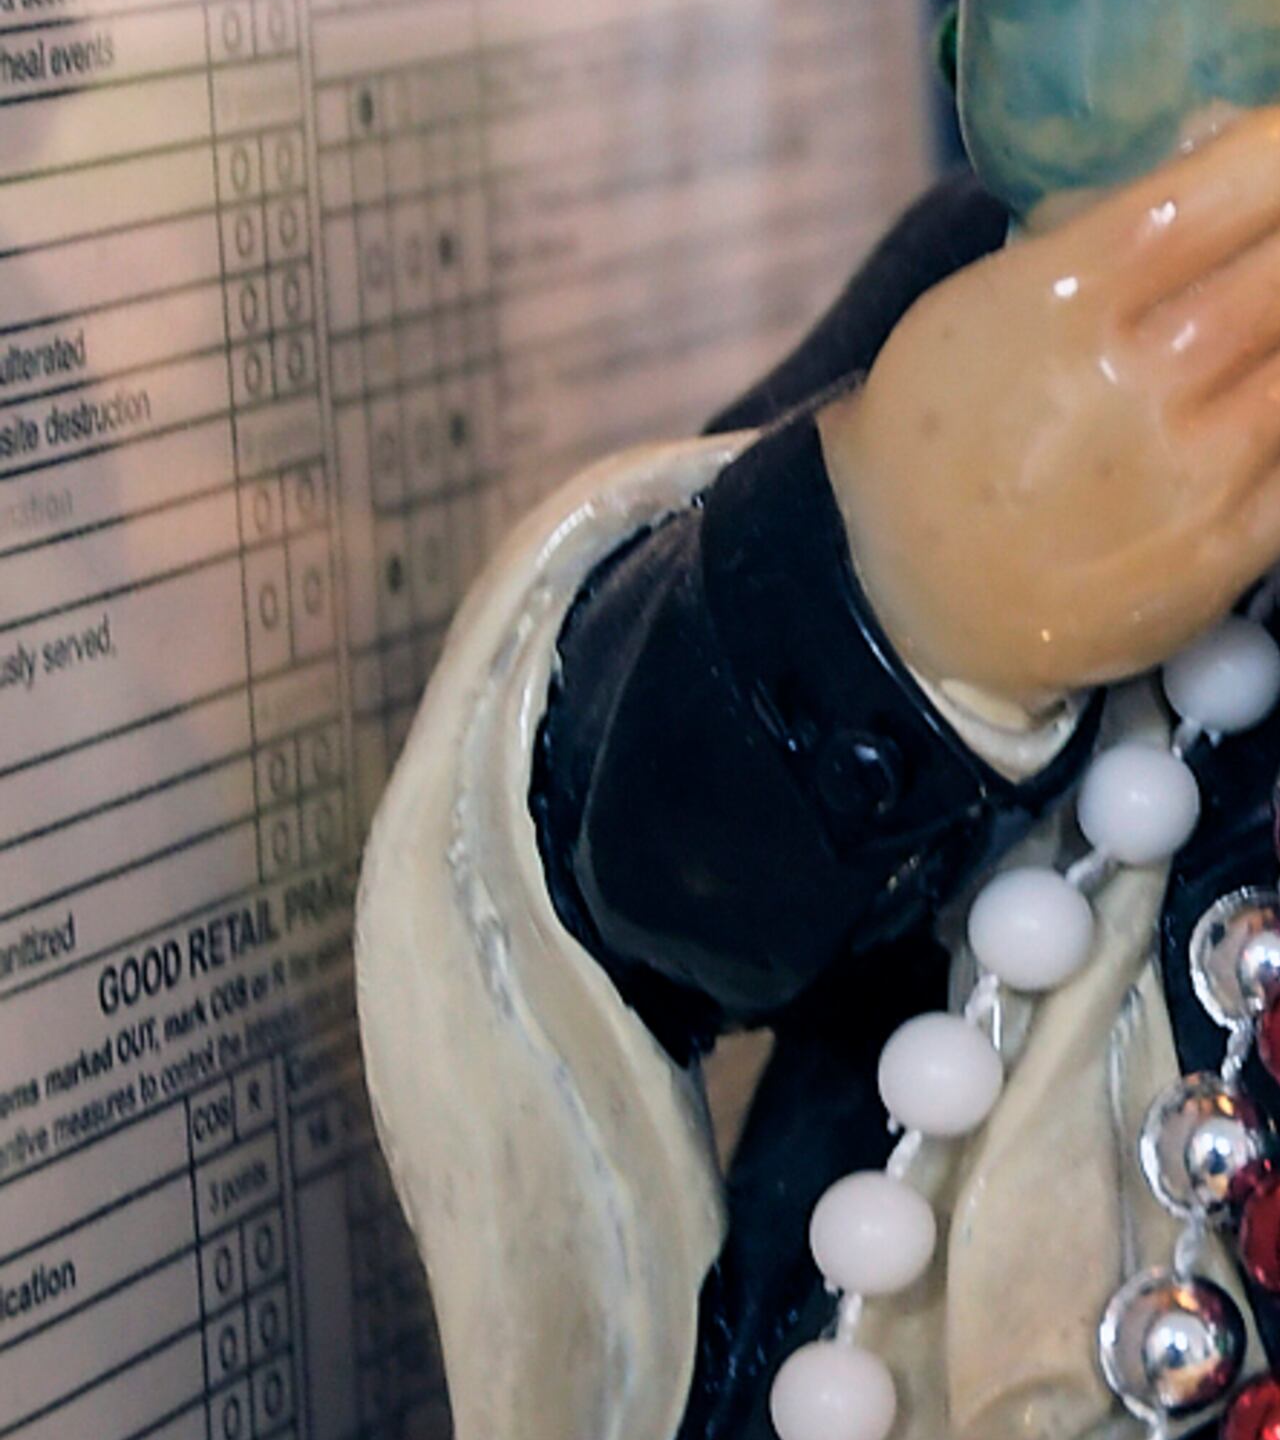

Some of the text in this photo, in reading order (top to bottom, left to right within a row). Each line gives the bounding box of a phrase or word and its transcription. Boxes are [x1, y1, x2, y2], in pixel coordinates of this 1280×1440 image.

[45, 388, 151, 447] destruction
[98, 938, 182, 1016] GOOD
[187, 898, 281, 979] RETAIL
[46, 1034, 113, 1098] marked
[116, 1017, 160, 1064] OUT,
[164, 997, 207, 1043] mark
[139, 1068, 157, 1106] to
[193, 1079, 261, 1142] COS R
